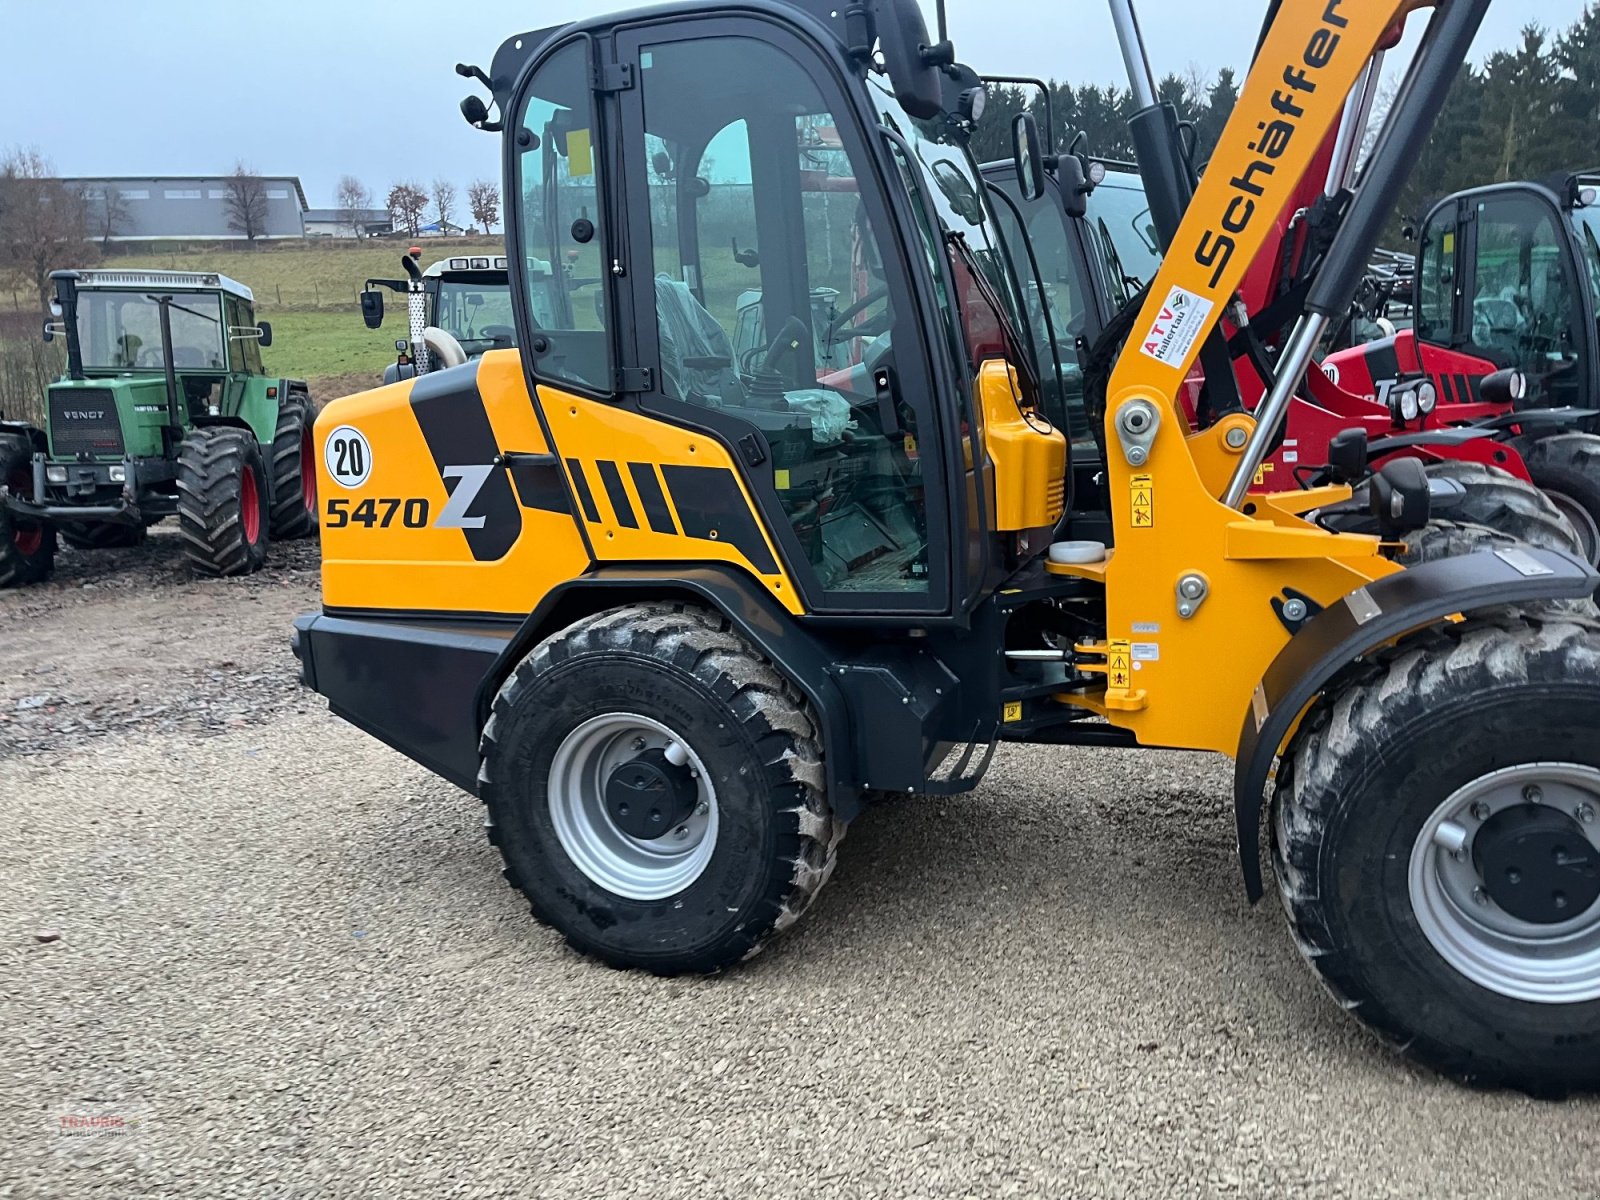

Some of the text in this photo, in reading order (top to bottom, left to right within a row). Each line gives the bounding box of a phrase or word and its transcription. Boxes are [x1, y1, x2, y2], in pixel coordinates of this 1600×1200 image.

[1195, 0, 1349, 289] Schäffer
[1155, 311, 1185, 359] Hallertau
[63, 410, 105, 420] FENDT
[334, 438, 364, 477] 20
[326, 464, 496, 529] 5470 Z
